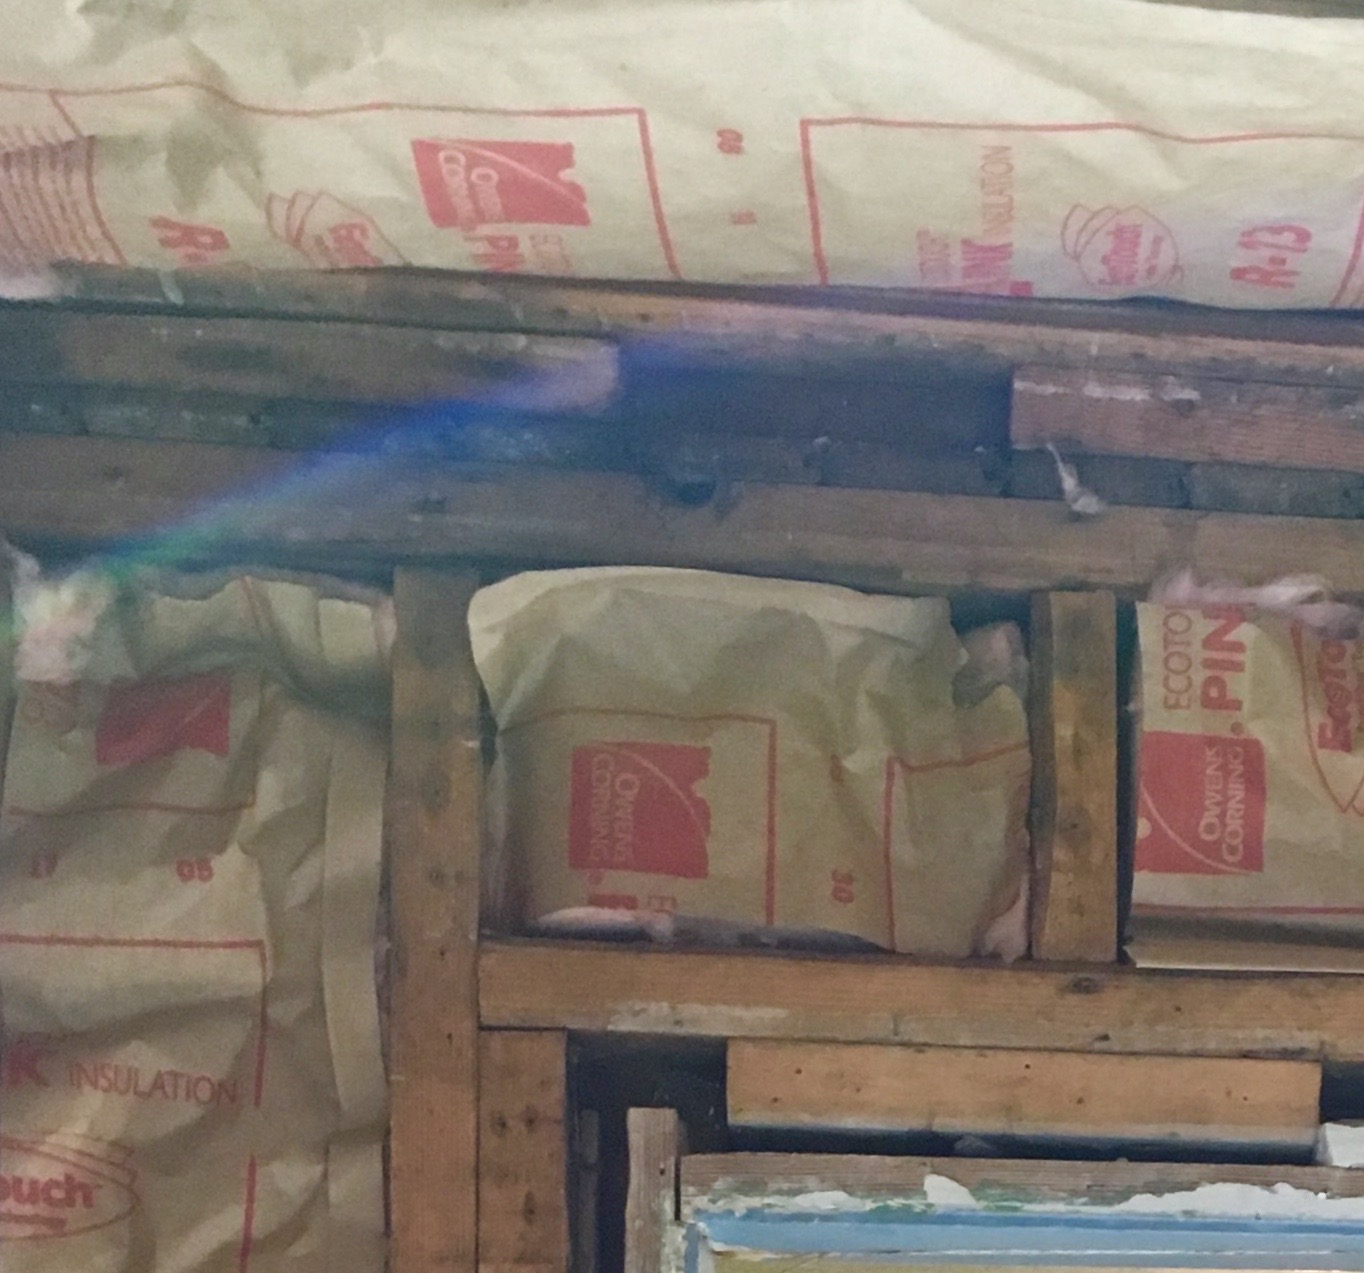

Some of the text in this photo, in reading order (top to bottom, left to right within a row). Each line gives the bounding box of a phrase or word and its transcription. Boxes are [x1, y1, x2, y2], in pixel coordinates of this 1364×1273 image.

[1199, 744, 1225, 842] OWENS
[1222, 746, 1246, 863] CORNING
[69, 1061, 238, 1103] INSULATION
